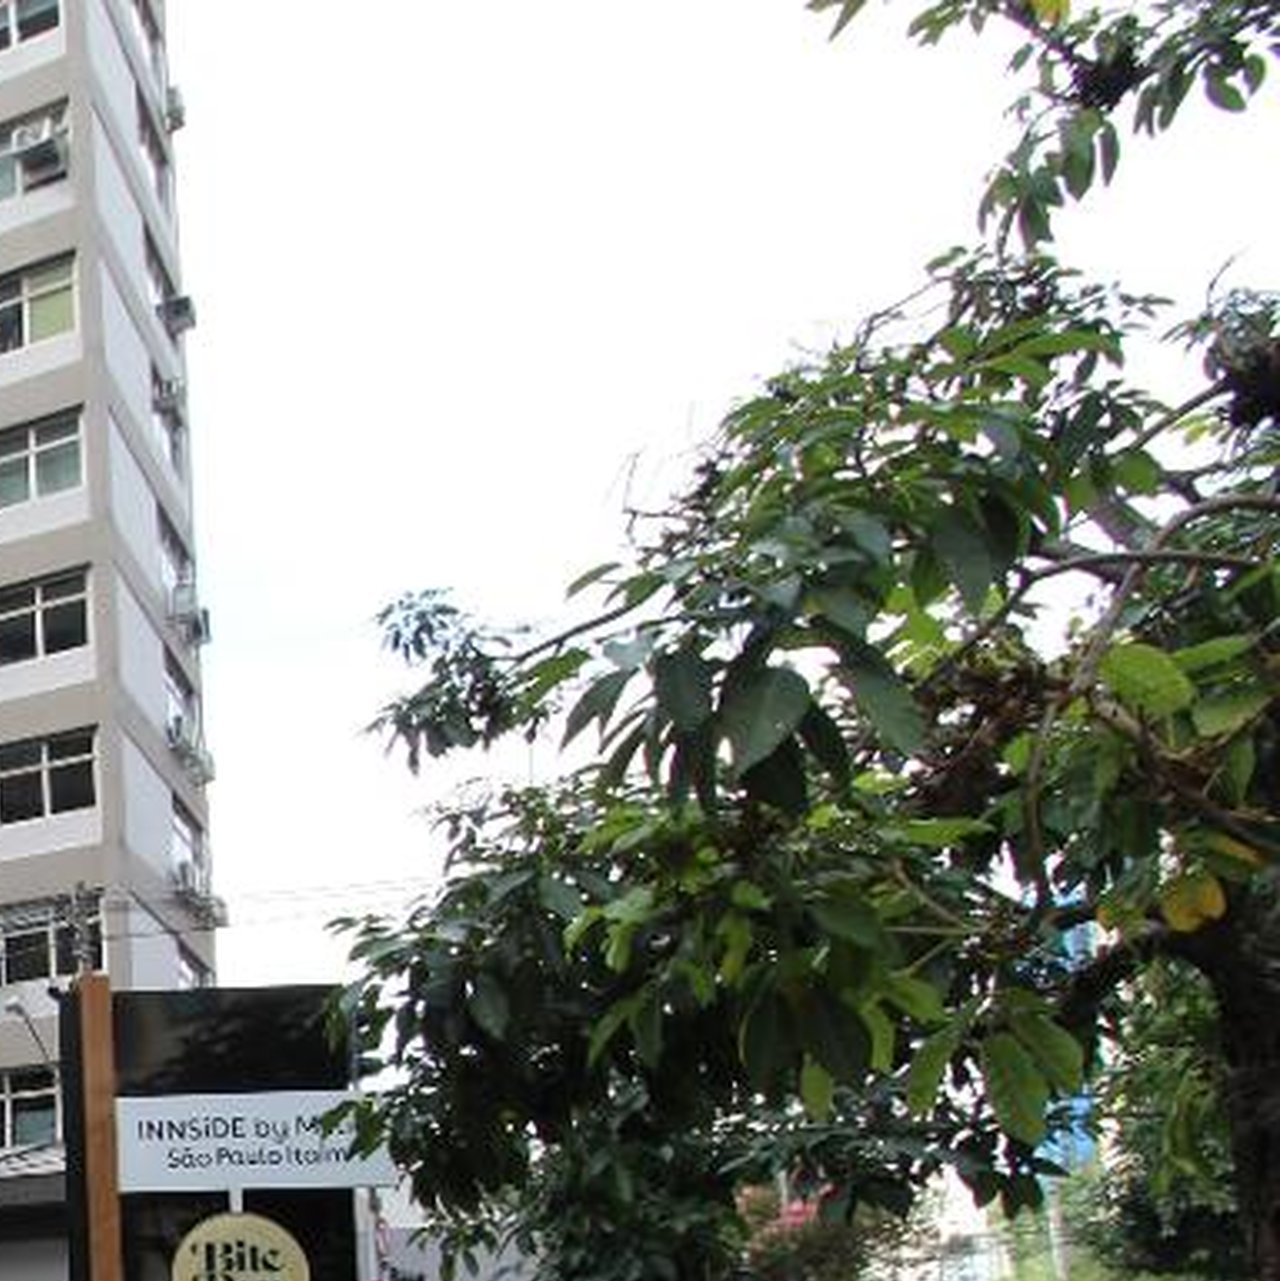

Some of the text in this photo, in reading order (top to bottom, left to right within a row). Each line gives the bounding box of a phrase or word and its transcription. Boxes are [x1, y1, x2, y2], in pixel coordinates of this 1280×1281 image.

[138, 1116, 245, 1140] INNSiDE
[254, 1116, 288, 1143] by
[167, 1147, 212, 1168] São
[215, 1147, 283, 1165] Paulo
